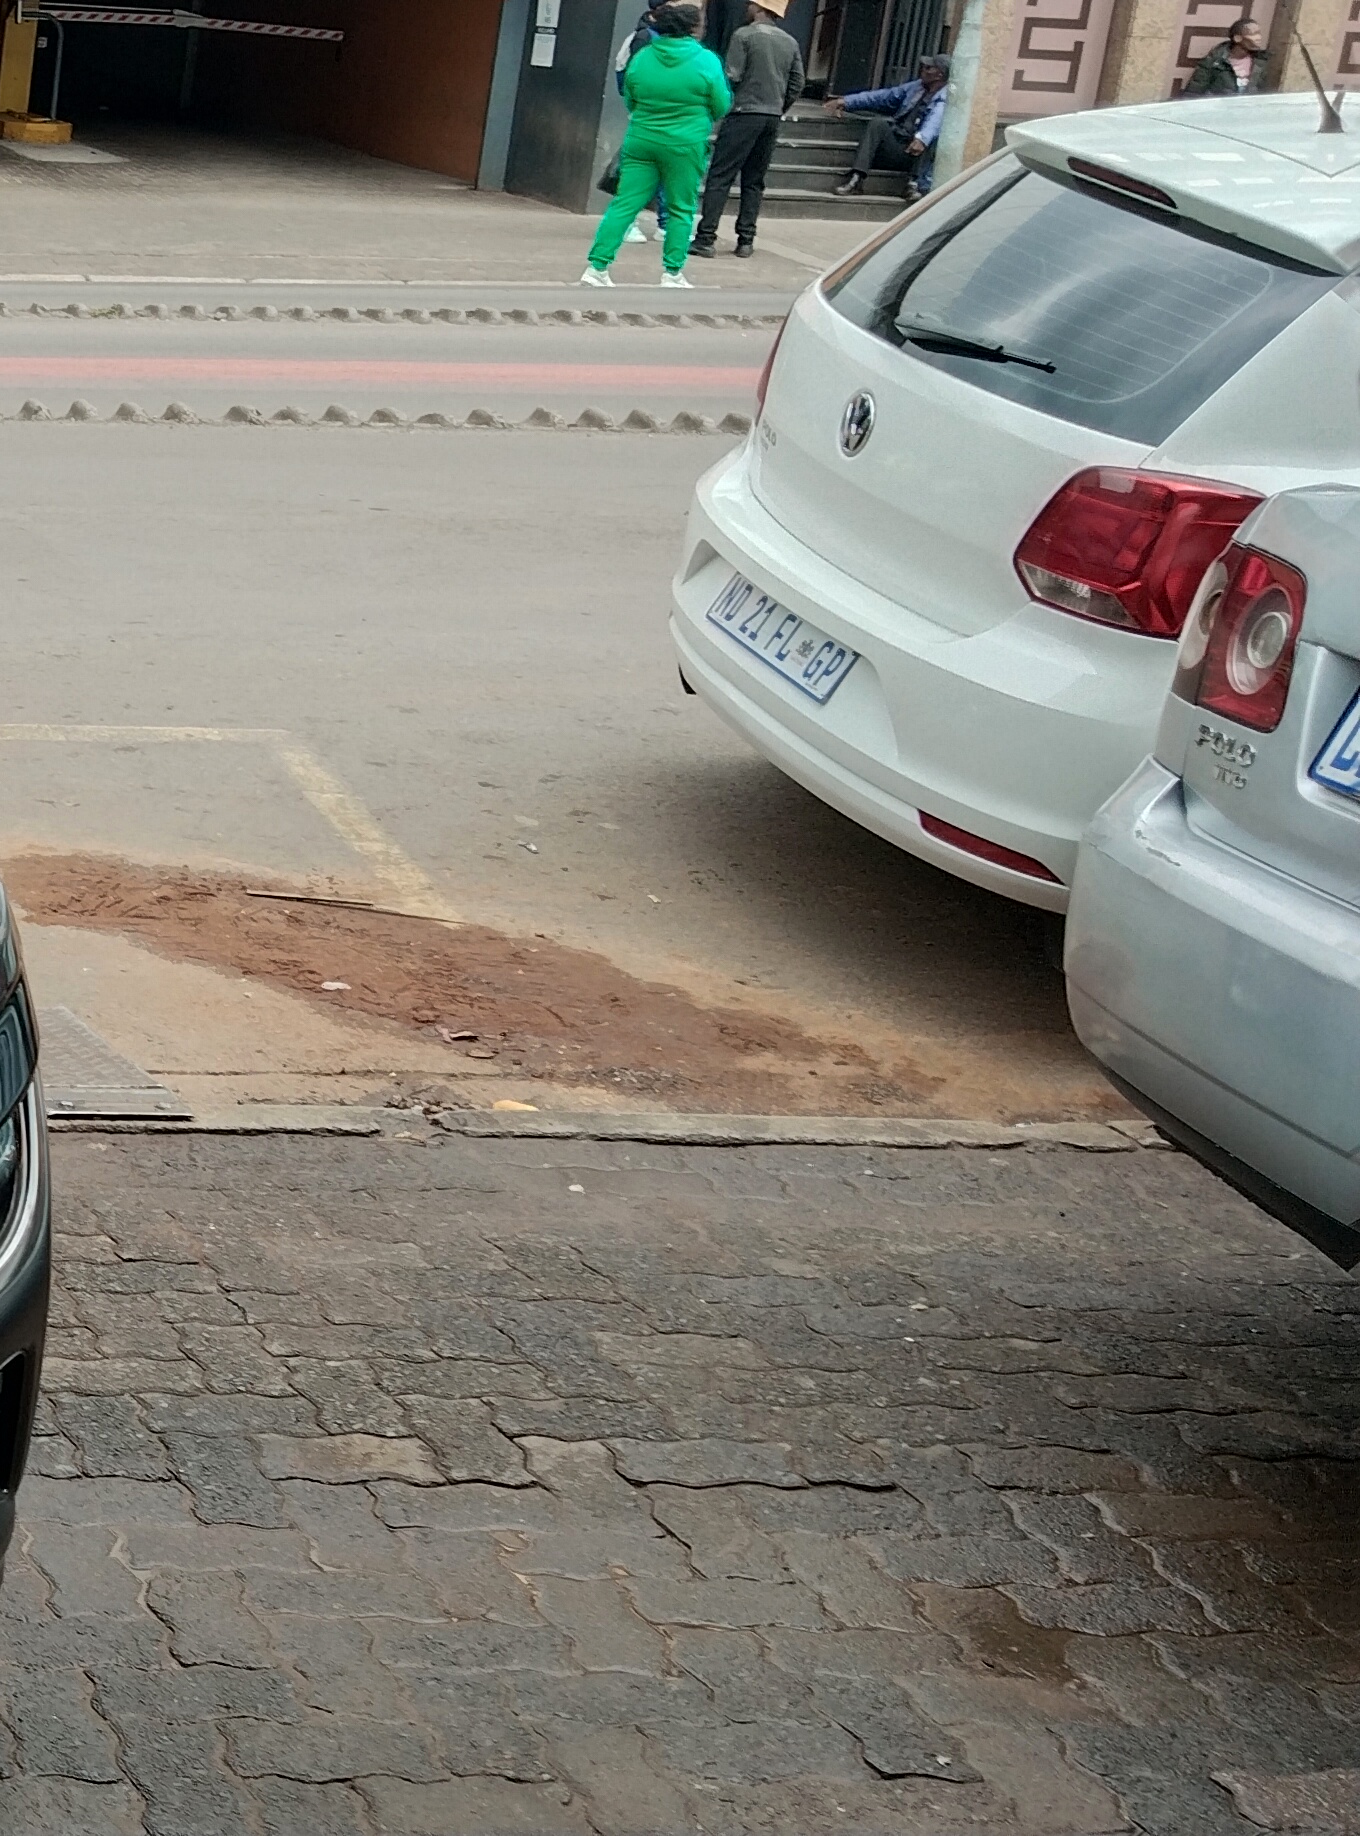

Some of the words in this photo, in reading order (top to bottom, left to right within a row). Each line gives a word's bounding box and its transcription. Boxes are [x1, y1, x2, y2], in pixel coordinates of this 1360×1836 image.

[715, 577, 753, 621] ND
[739, 596, 778, 641] 21
[764, 613, 803, 661] FL
[803, 641, 846, 685] GP
[1194, 724, 1256, 768] POLO
